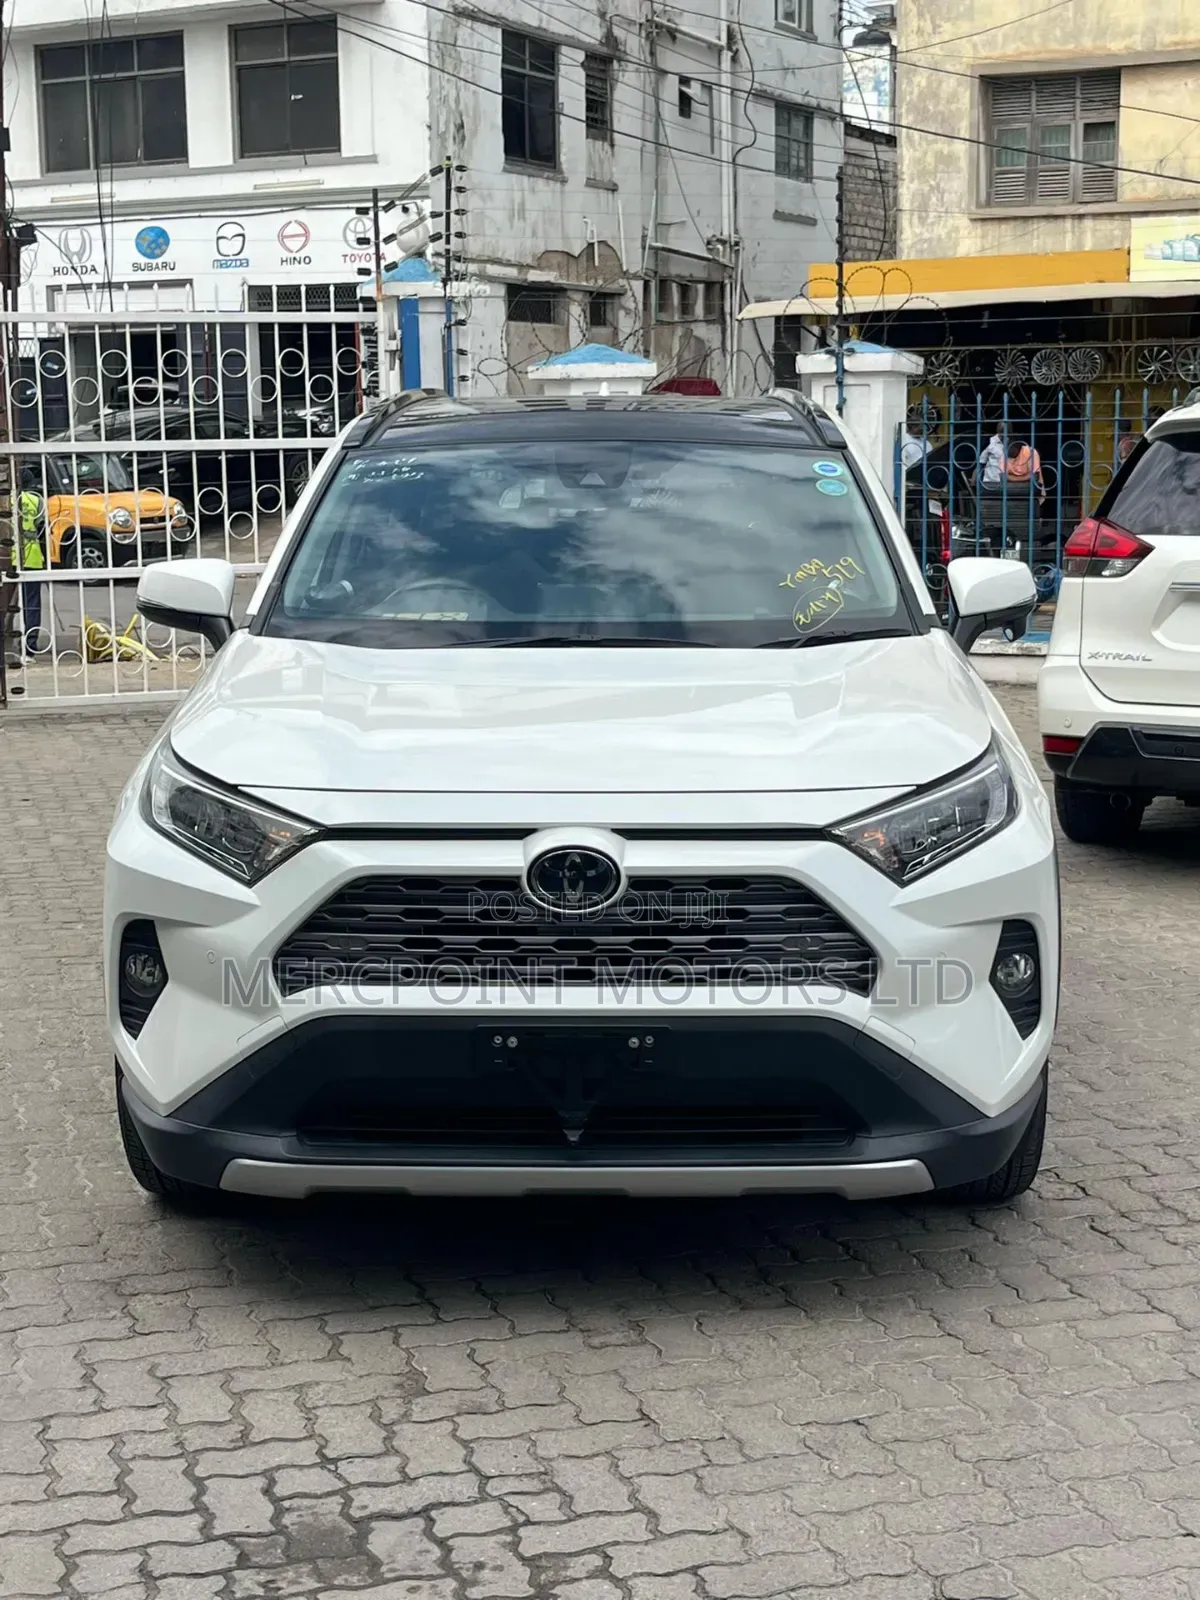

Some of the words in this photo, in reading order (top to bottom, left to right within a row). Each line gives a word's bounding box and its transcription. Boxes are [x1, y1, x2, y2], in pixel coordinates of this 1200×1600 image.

[280, 255, 312, 266] HINO
[53, 265, 98, 276] HONDA
[132, 261, 176, 272] SUBARU
[1088, 651, 1153, 662] X-TRAIL
